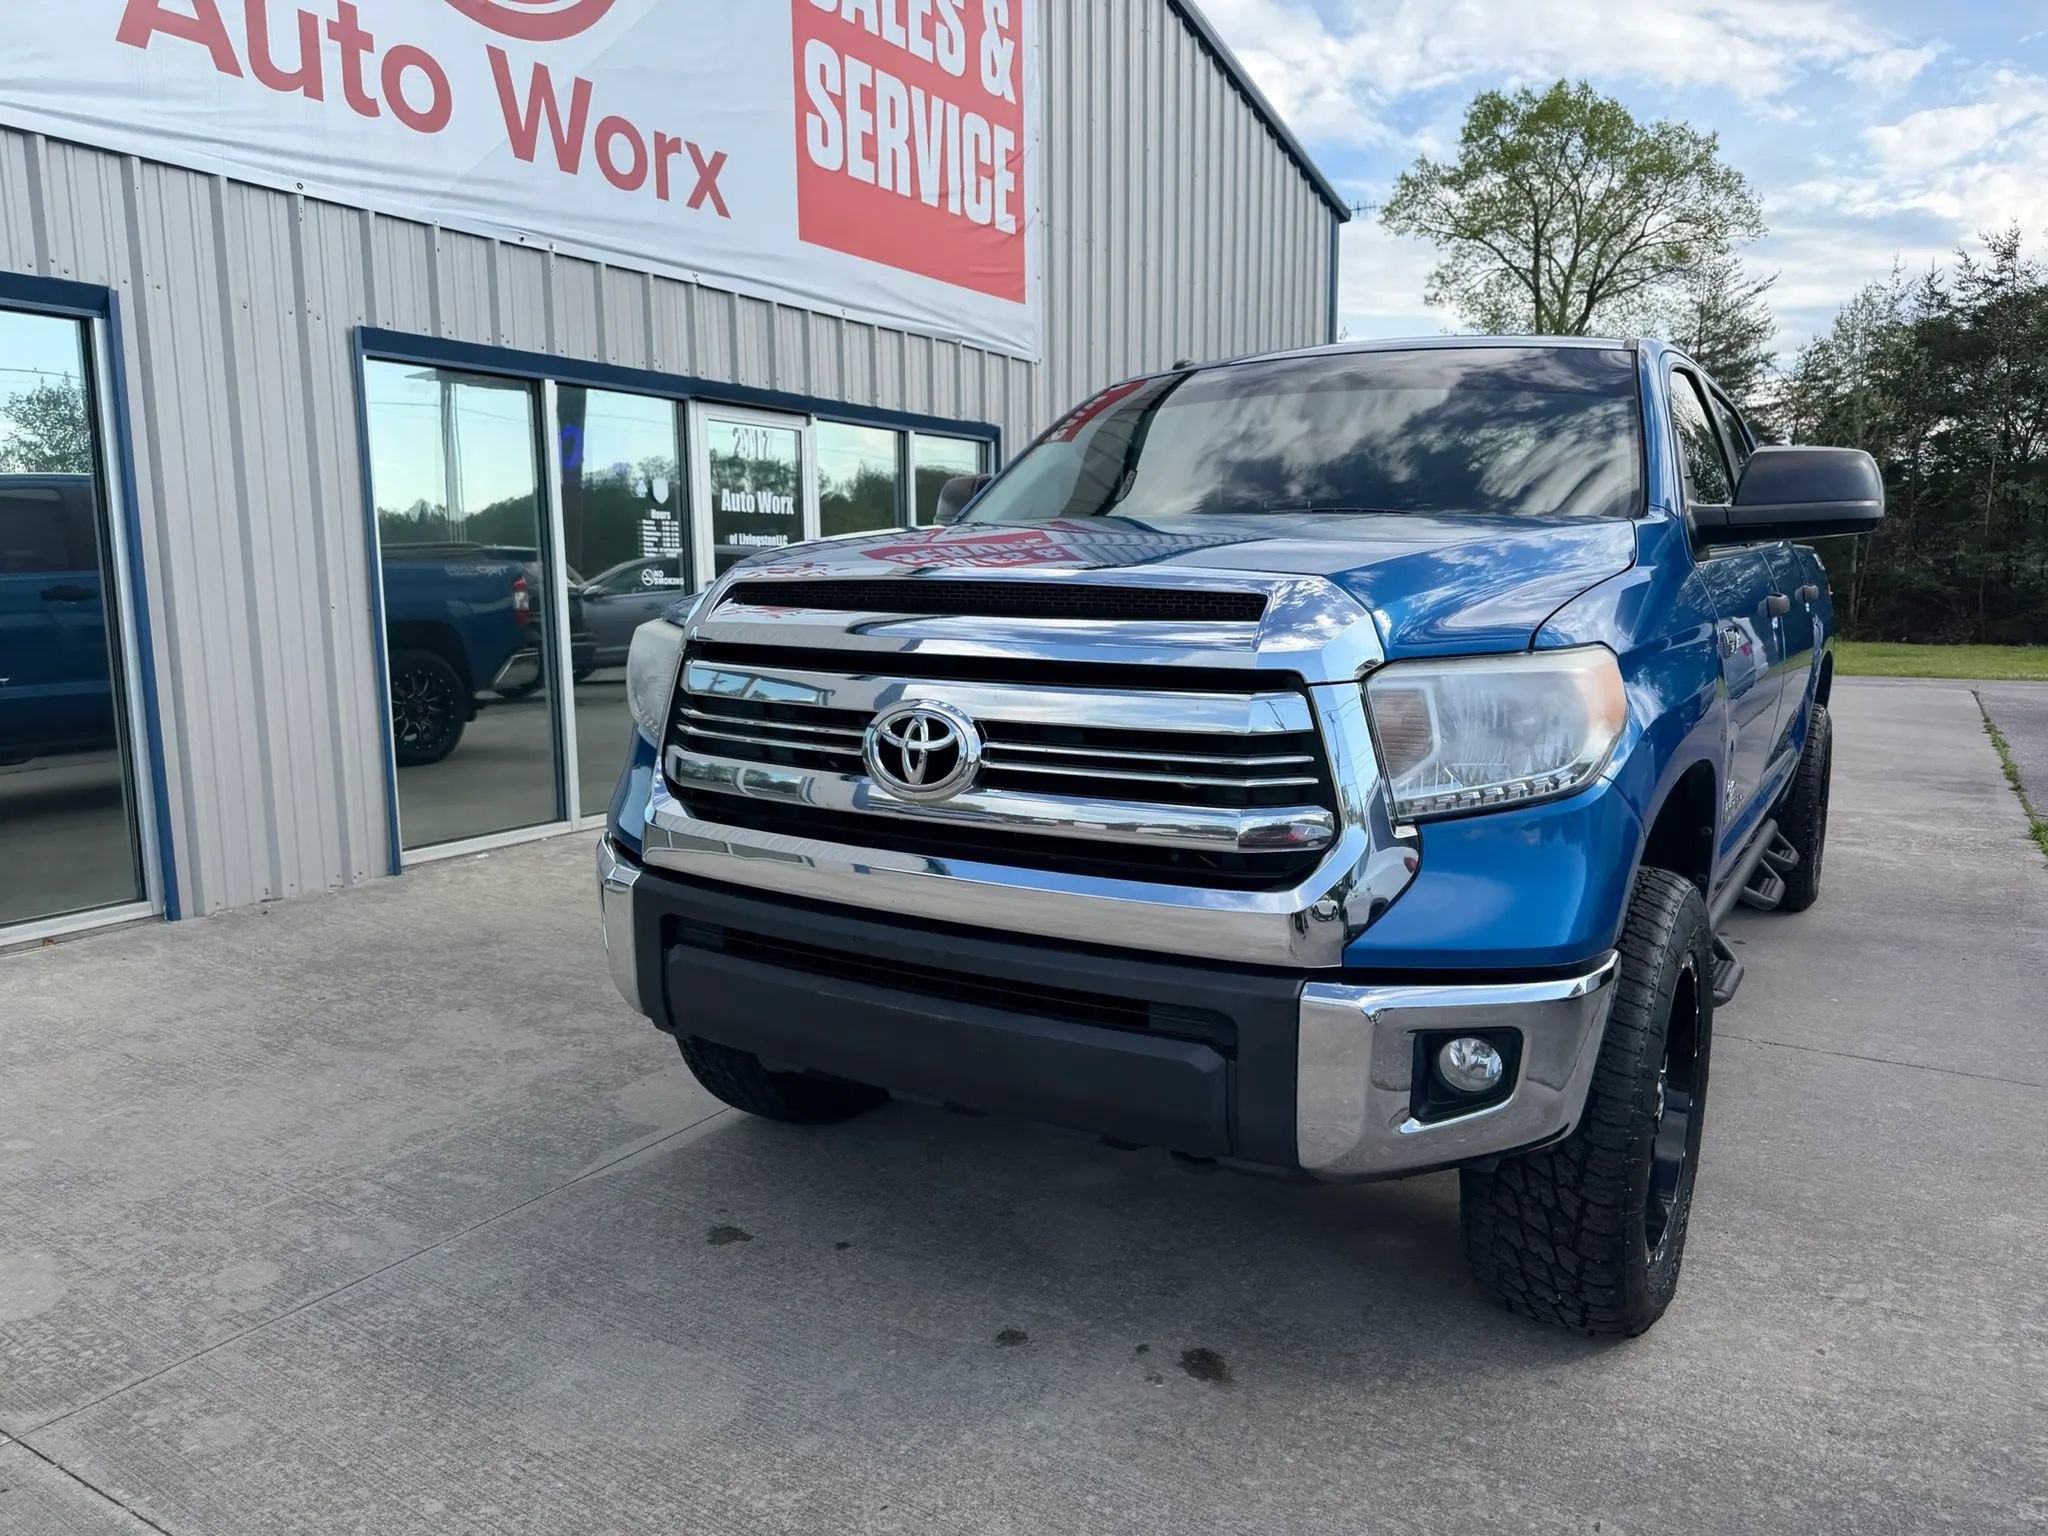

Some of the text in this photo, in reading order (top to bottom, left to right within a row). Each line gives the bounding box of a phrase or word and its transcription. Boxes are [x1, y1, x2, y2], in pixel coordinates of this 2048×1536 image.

[980, 0, 1017, 105] &
[115, 0, 732, 219] Auto Worx
[804, 38, 1016, 235] SERVICE
[721, 488, 795, 515] Auto Worx
[653, 569, 664, 578] NO
